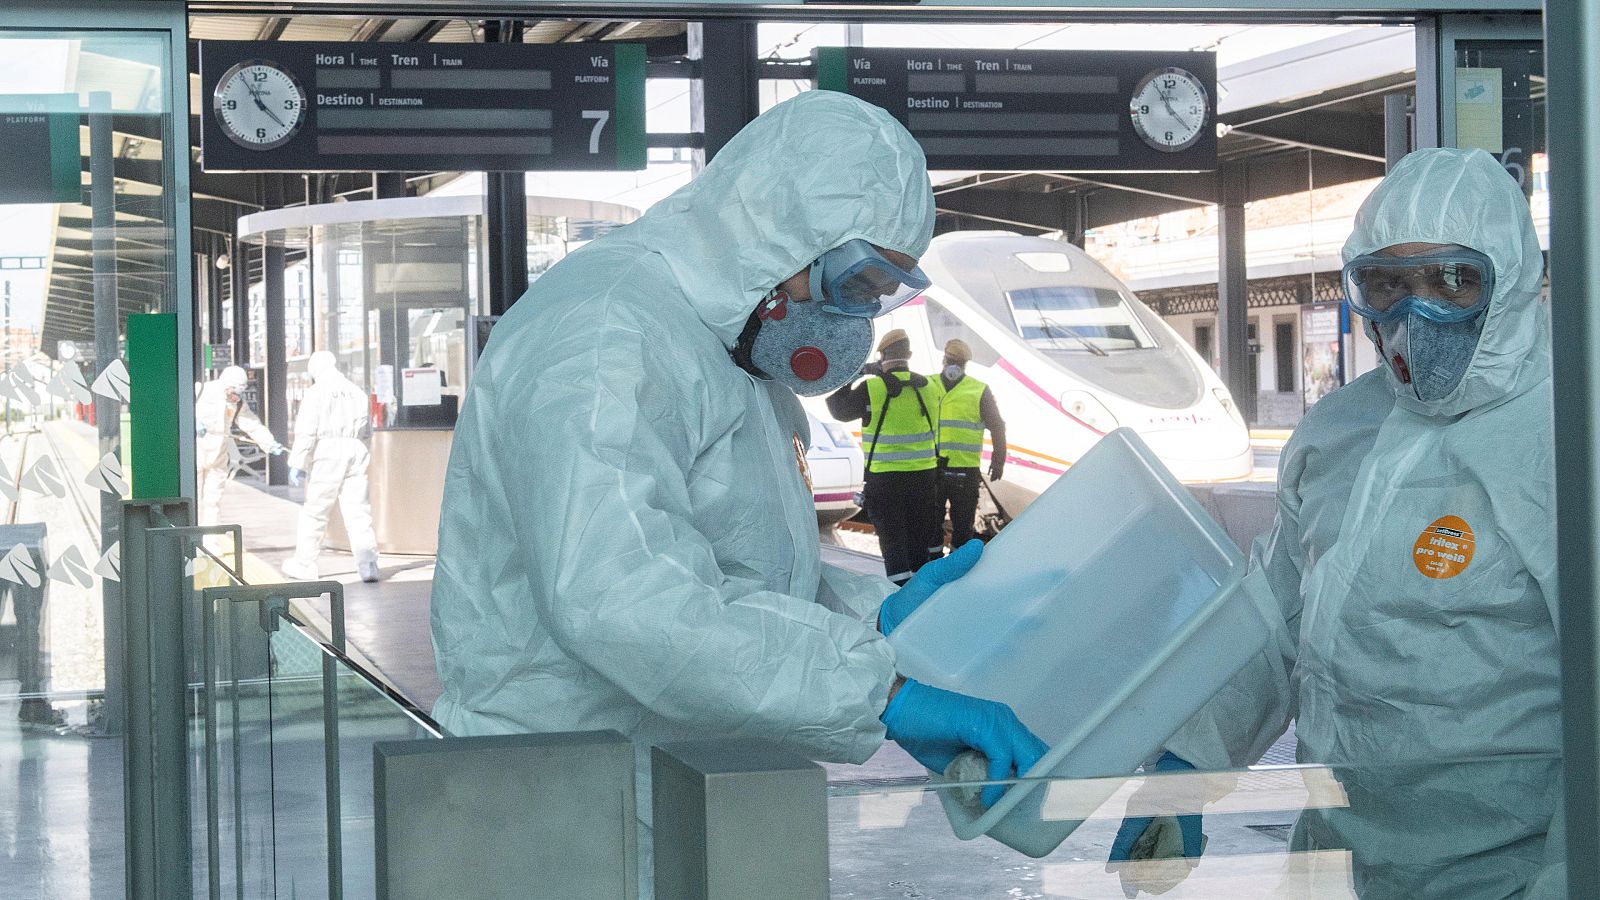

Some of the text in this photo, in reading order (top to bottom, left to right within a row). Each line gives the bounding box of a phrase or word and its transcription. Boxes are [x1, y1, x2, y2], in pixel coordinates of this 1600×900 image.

[316, 54, 345, 65] Hora
[360, 58, 378, 66] TIME
[392, 54, 419, 66] Tren
[591, 56, 609, 68] Vía
[853, 58, 871, 70] Vía
[907, 60, 933, 71] Hora
[975, 60, 999, 71] Tren
[252, 72, 267, 82] 12
[1163, 80, 1176, 89] 12
[317, 93, 423, 106] Destino DESTINATION
[907, 97, 1003, 109] Destino DESTINATION
[227, 100, 237, 110] 9
[284, 100, 293, 110] 3
[1141, 105, 1149, 114] 9
[1190, 106, 1198, 115] 3
[256, 128, 266, 138] 6
[582, 110, 609, 154] 7
[1165, 131, 1173, 141] 6
